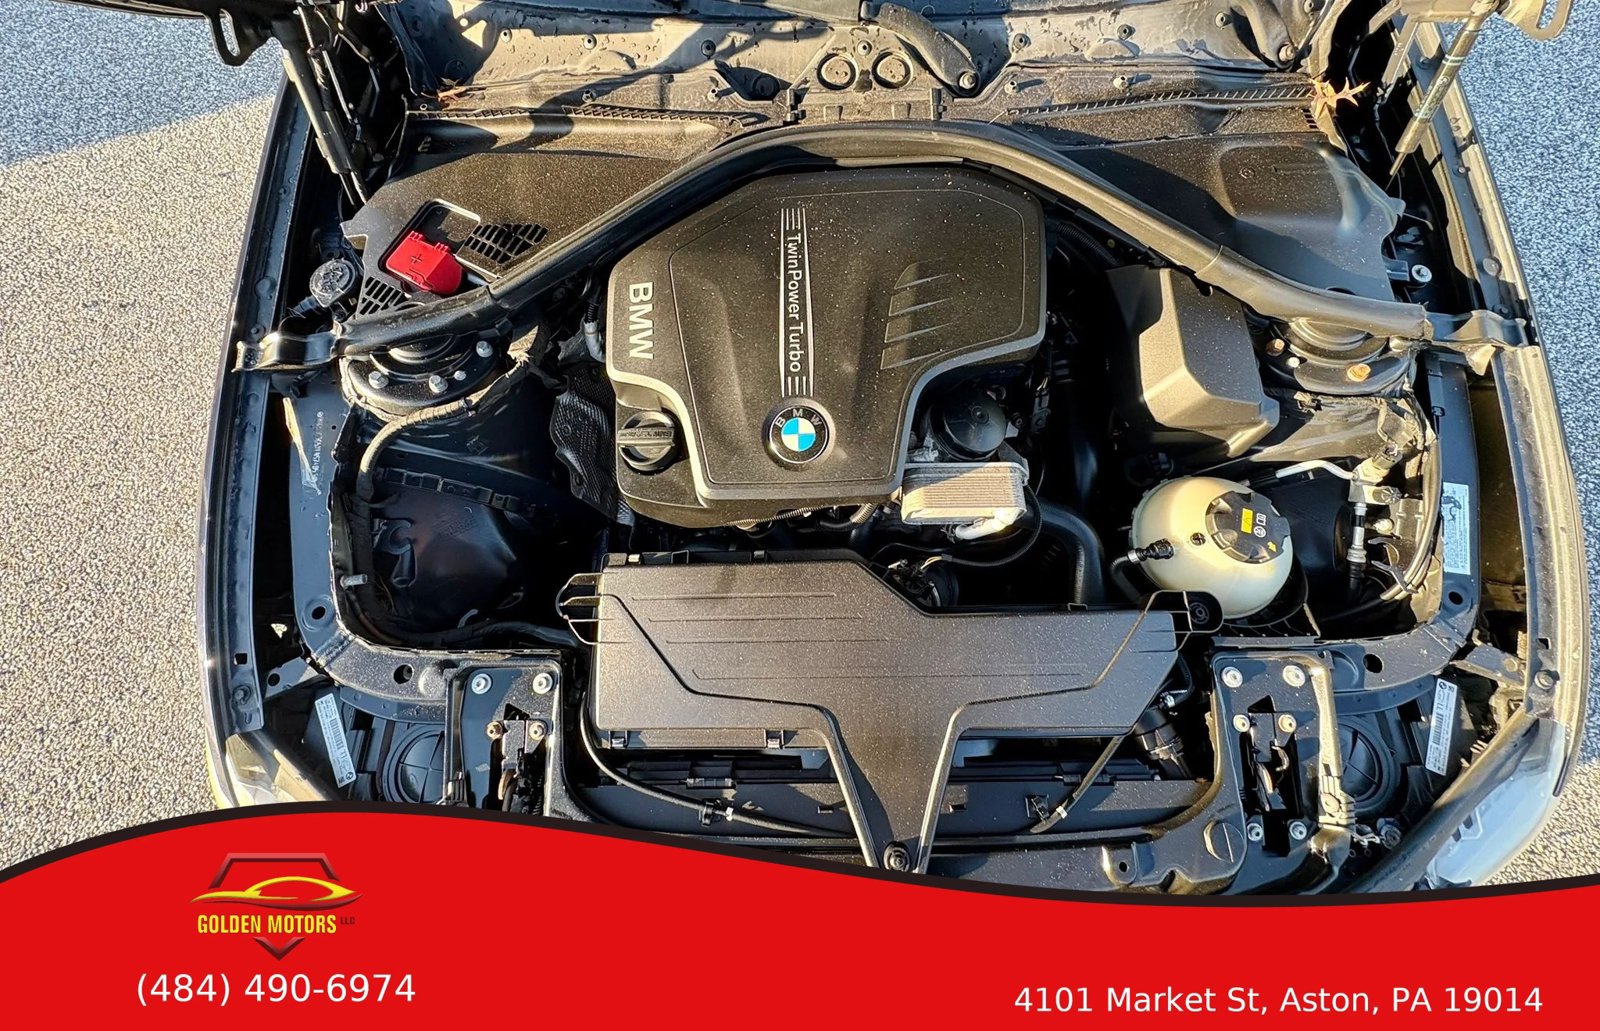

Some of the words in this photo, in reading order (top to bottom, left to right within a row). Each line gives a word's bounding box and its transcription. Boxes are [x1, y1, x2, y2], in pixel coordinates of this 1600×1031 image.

[786, 233, 802, 320] TwinPower
[628, 281, 654, 360] BMW
[788, 322, 804, 373] Turbo
[775, 408, 822, 428] BMW
